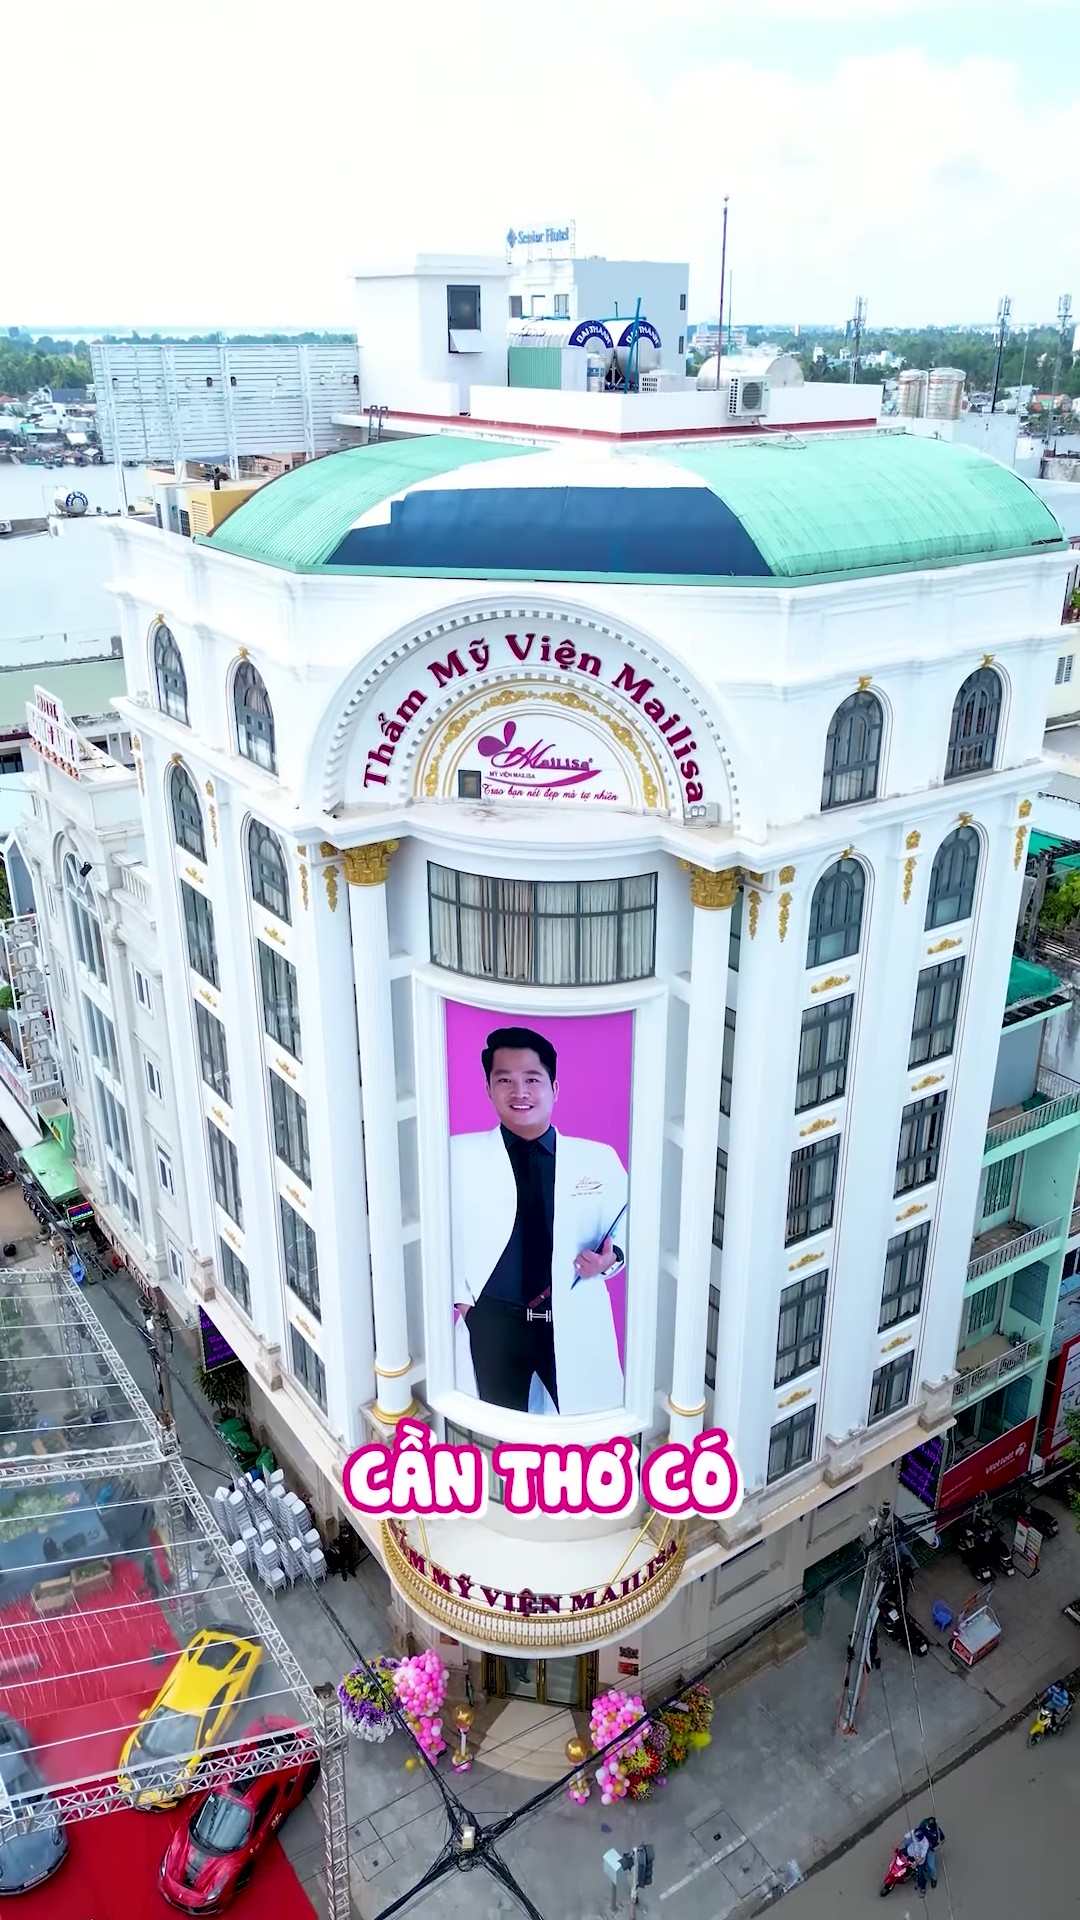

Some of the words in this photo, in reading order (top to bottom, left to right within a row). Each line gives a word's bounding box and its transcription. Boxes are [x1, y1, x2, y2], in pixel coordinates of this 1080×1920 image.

[363, 690, 428, 789] Thẩm
[427, 638, 491, 688] Mỹ
[505, 633, 603, 677] Viện
[611, 662, 705, 804] Mailisa
[431, 1564, 474, 1600] MỸ
[480, 1587, 561, 1617] VIỆN
[570, 1539, 679, 1613] MAILISA
